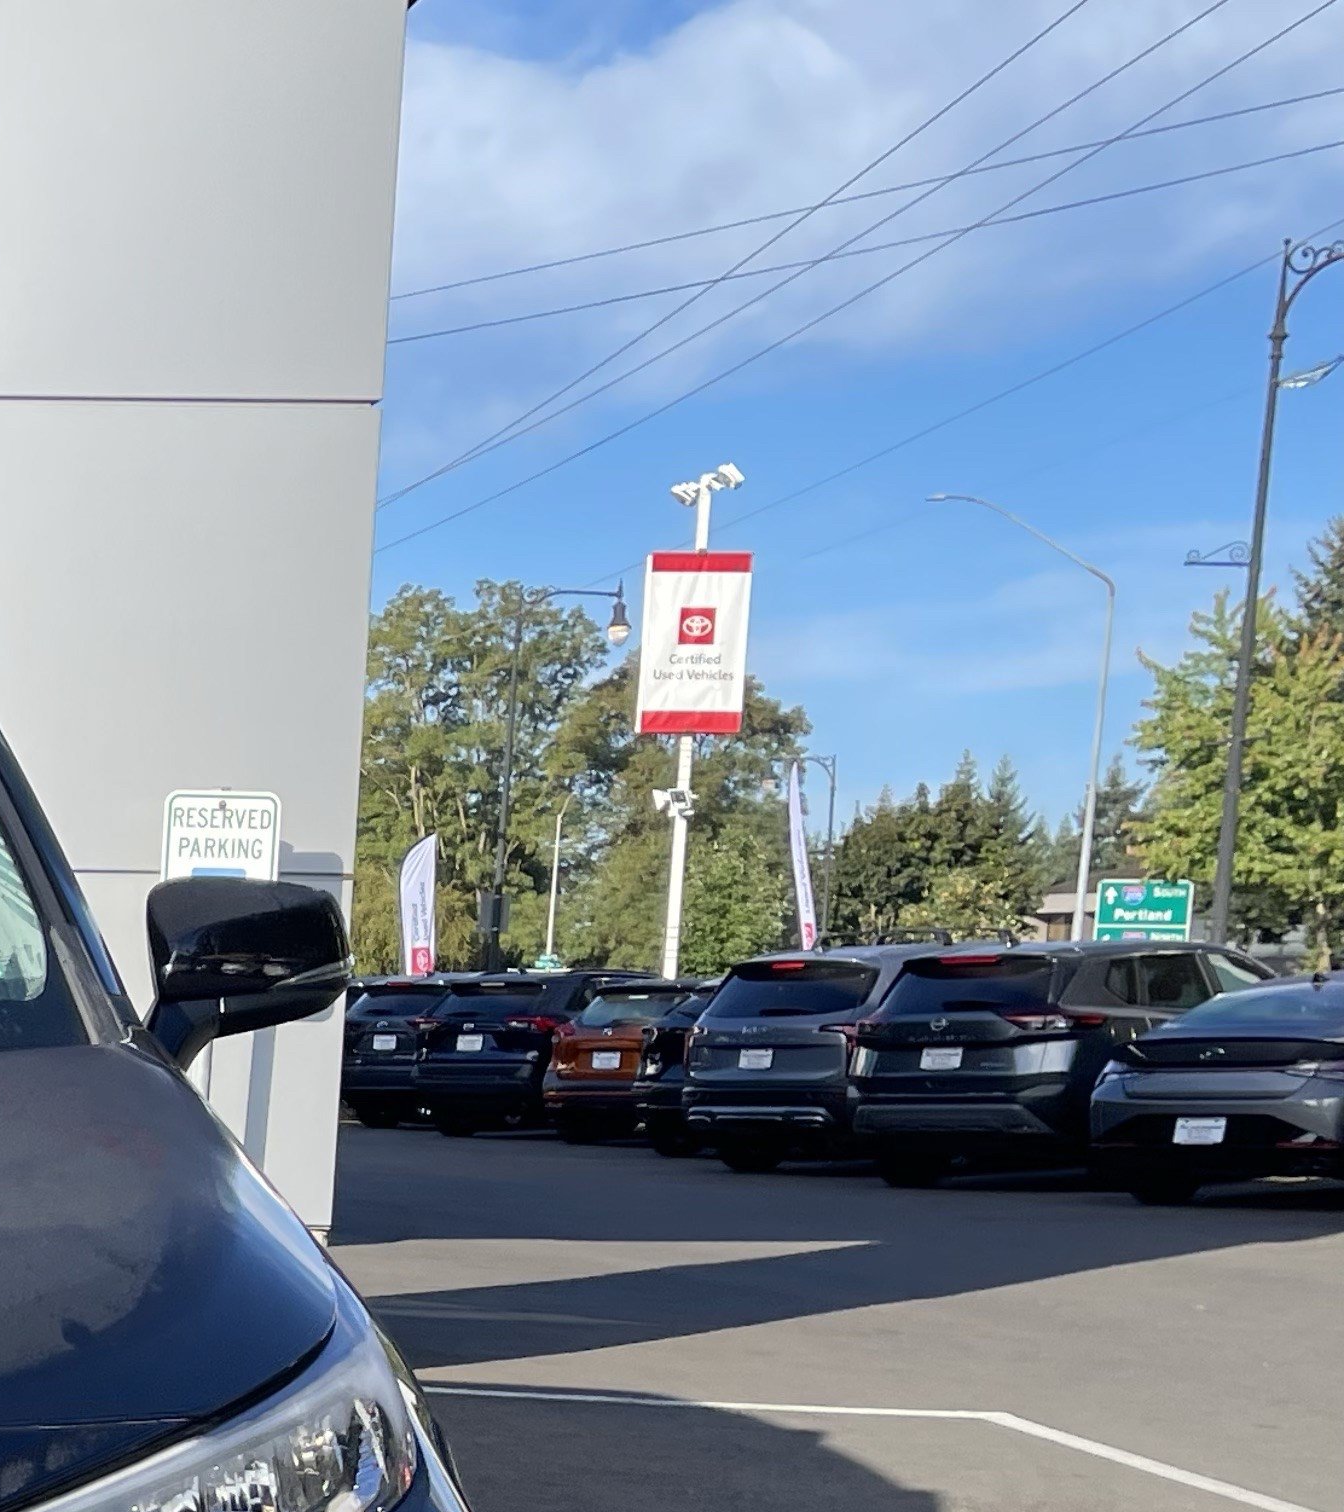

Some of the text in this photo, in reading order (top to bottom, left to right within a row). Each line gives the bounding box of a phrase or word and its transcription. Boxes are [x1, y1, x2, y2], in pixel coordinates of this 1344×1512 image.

[669, 653, 721, 665] Certified
[653, 669, 734, 681] Used Vehicles
[173, 807, 273, 830] RESERVED
[178, 837, 264, 860] PARKING
[1113, 908, 1172, 920] Portland
